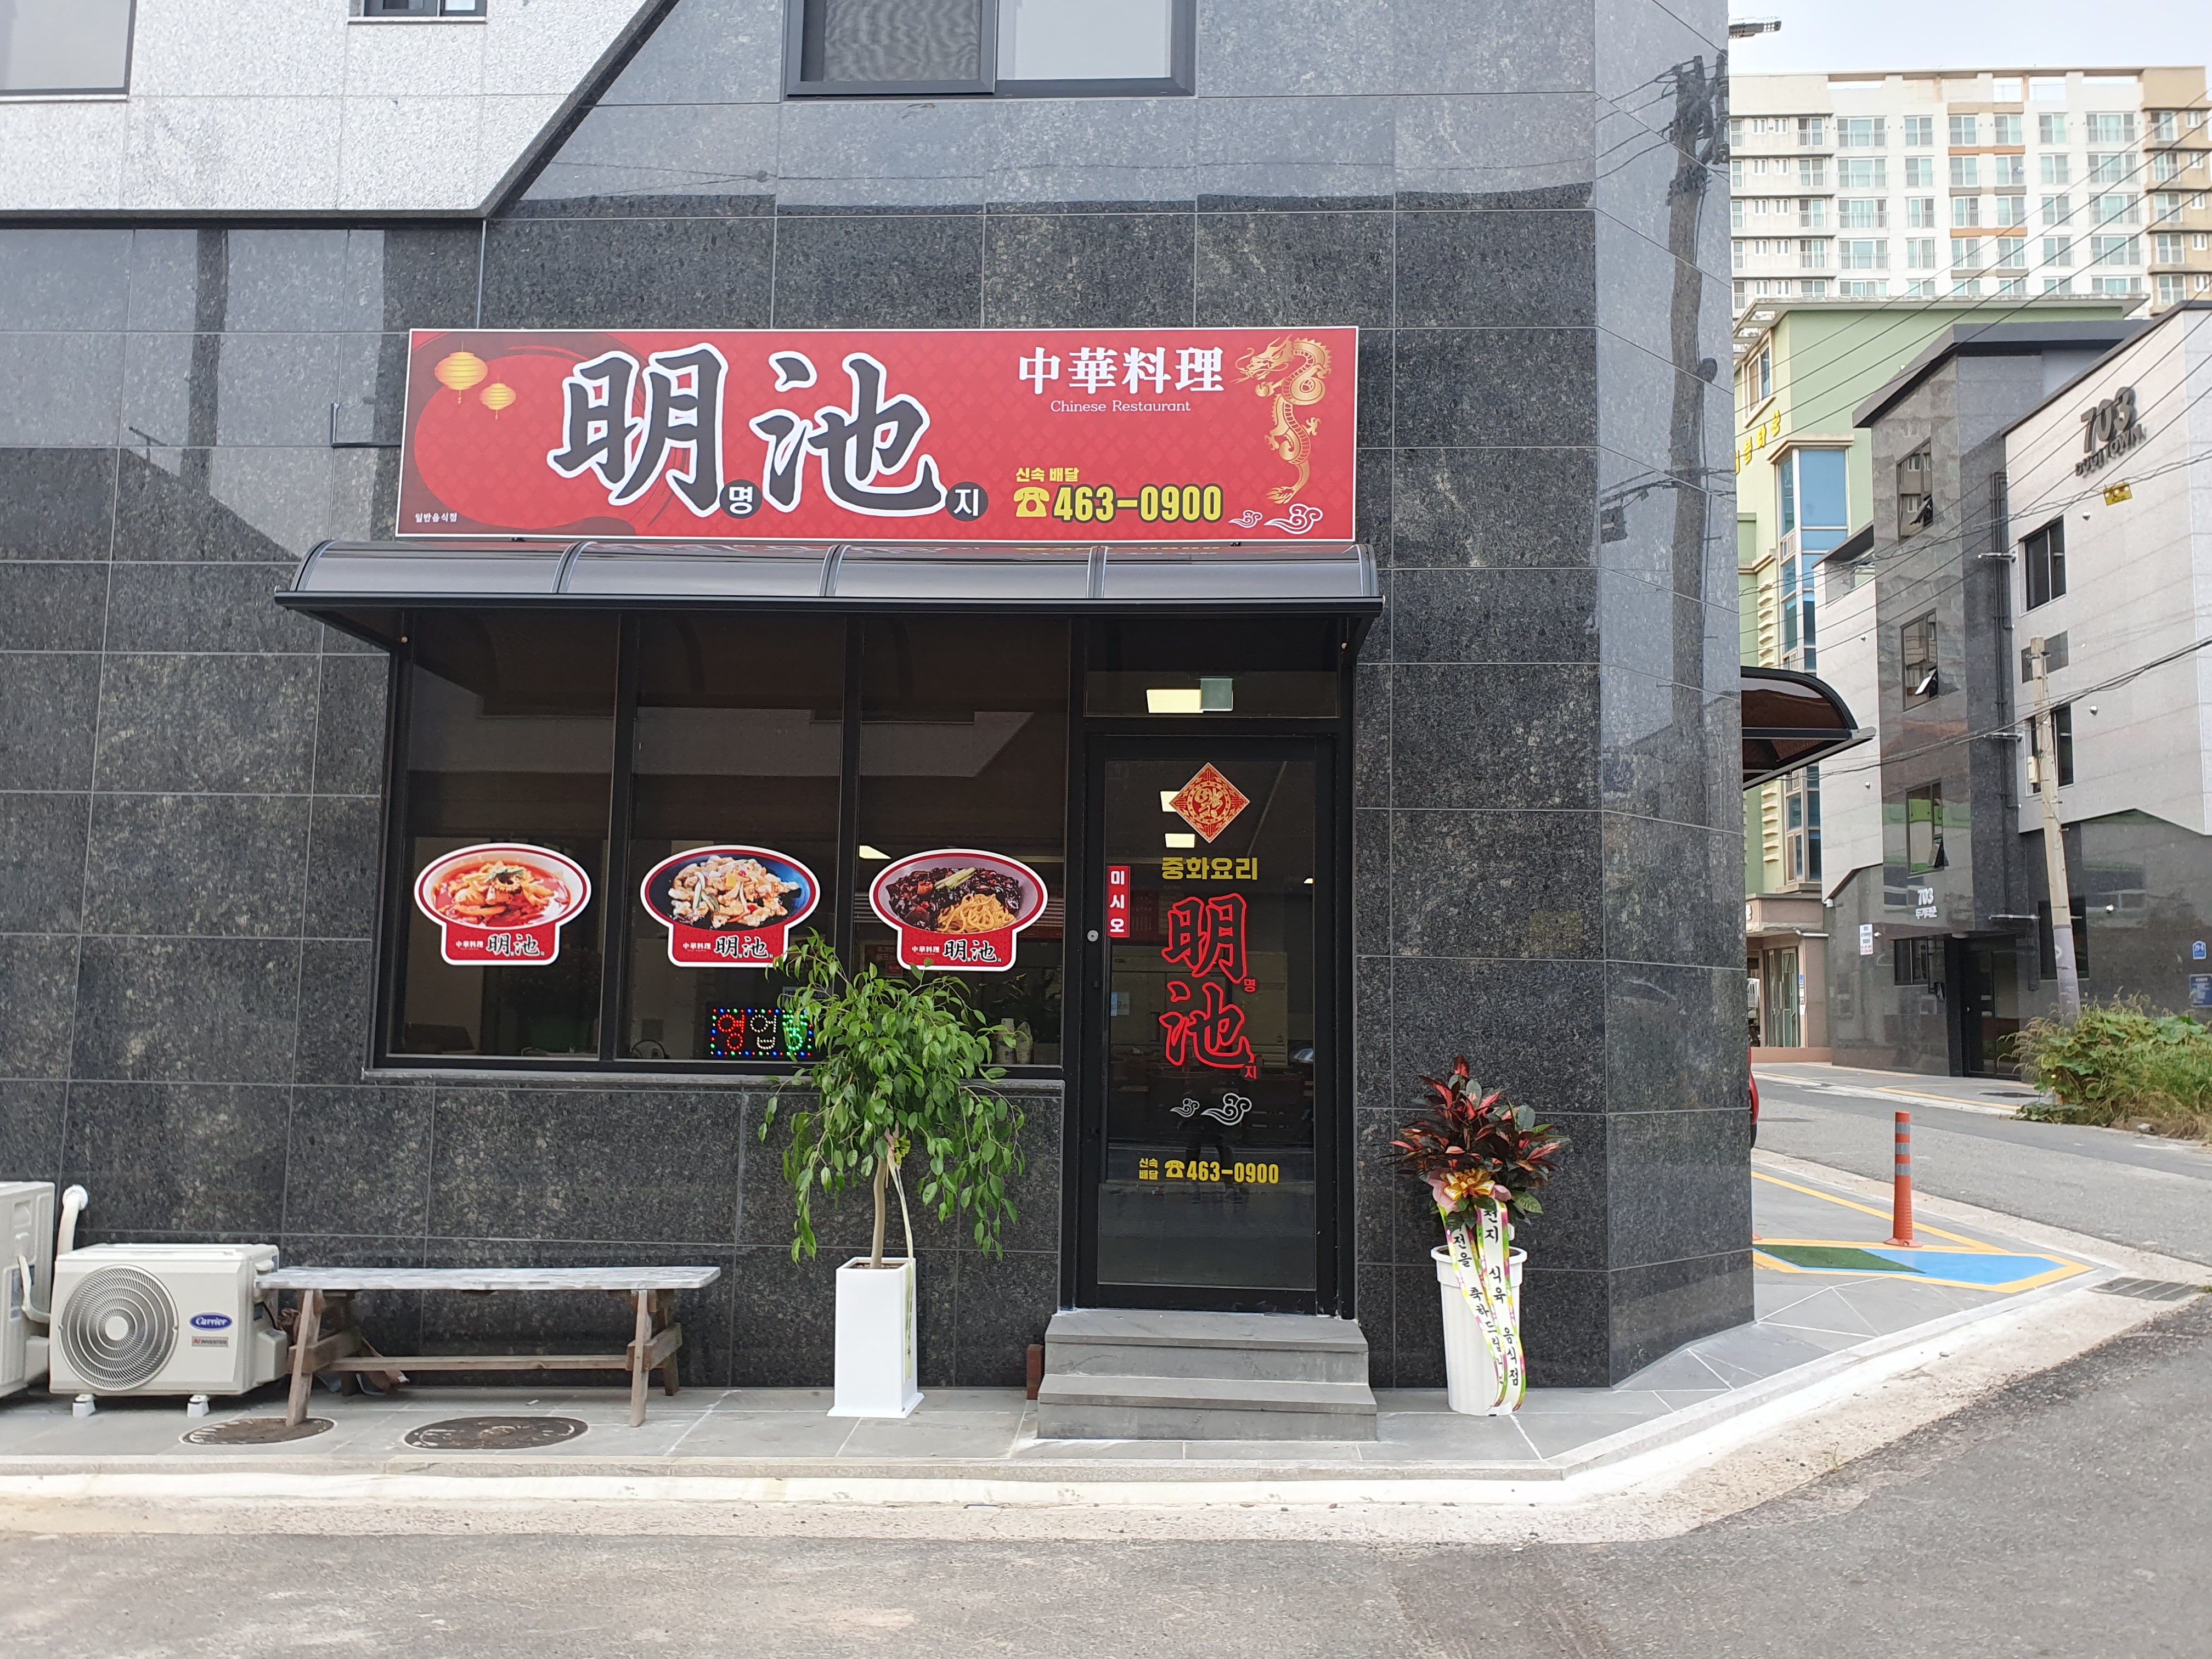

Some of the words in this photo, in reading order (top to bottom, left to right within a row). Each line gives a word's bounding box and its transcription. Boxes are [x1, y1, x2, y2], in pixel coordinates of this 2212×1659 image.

[1019, 347, 1224, 394] 中華料理
[1051, 400, 1107, 412] Chinese
[1112, 399, 1191, 412] Restaurant
[2080, 387, 2136, 453] 703
[1015, 467, 1045, 483] 신속
[1049, 467, 1080, 483] 배달
[728, 486, 754, 515] 명
[953, 488, 979, 516] 지
[1053, 485, 1222, 522] 463-0900
[415, 512, 458, 523] 일반음식점
[1161, 857, 1258, 881] 중화요리
[1109, 870, 1125, 933] 미시오
[1917, 887, 1934, 906] 703
[1243, 978, 1256, 993] 명
[716, 1013, 808, 1051] 영업중
[1244, 1065, 1257, 1080] 지
[1138, 1158, 1158, 1169] 신속
[1138, 1169, 1159, 1181] 배달
[1186, 1161, 1279, 1184] 463-0900
[195, 1317, 228, 1326] Carrier
[1488, 1265, 1506, 1305] 식육
[1503, 1327, 1519, 1386] 음식점
